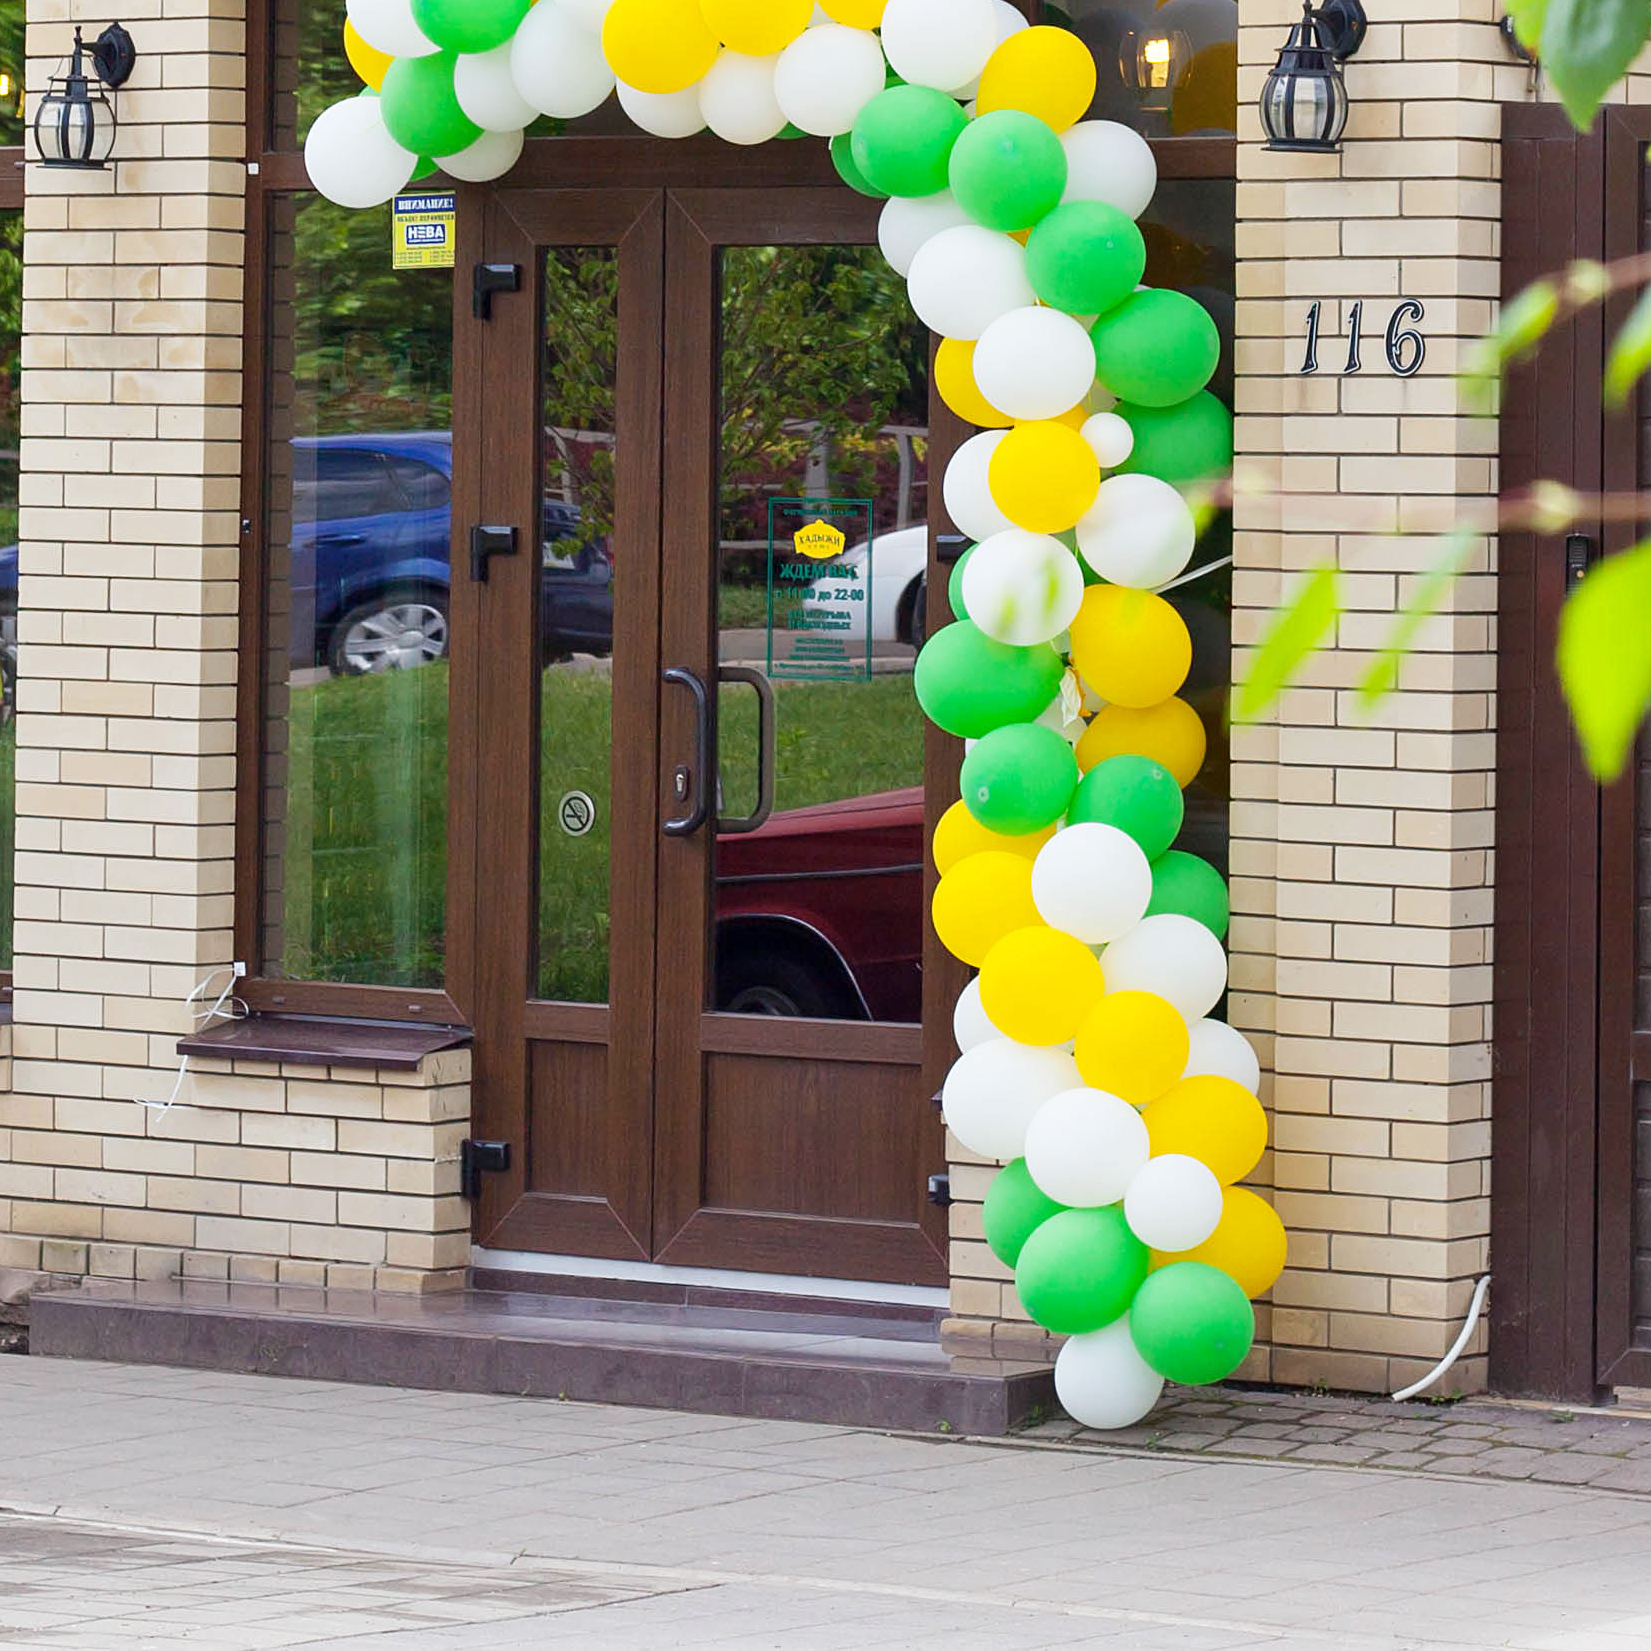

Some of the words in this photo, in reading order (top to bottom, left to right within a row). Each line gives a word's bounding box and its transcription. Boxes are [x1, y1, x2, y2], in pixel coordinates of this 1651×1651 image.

[407, 225, 444, 239] НЕВА
[1300, 298, 1426, 378] 116
[833, 588, 865, 601] 22-00
